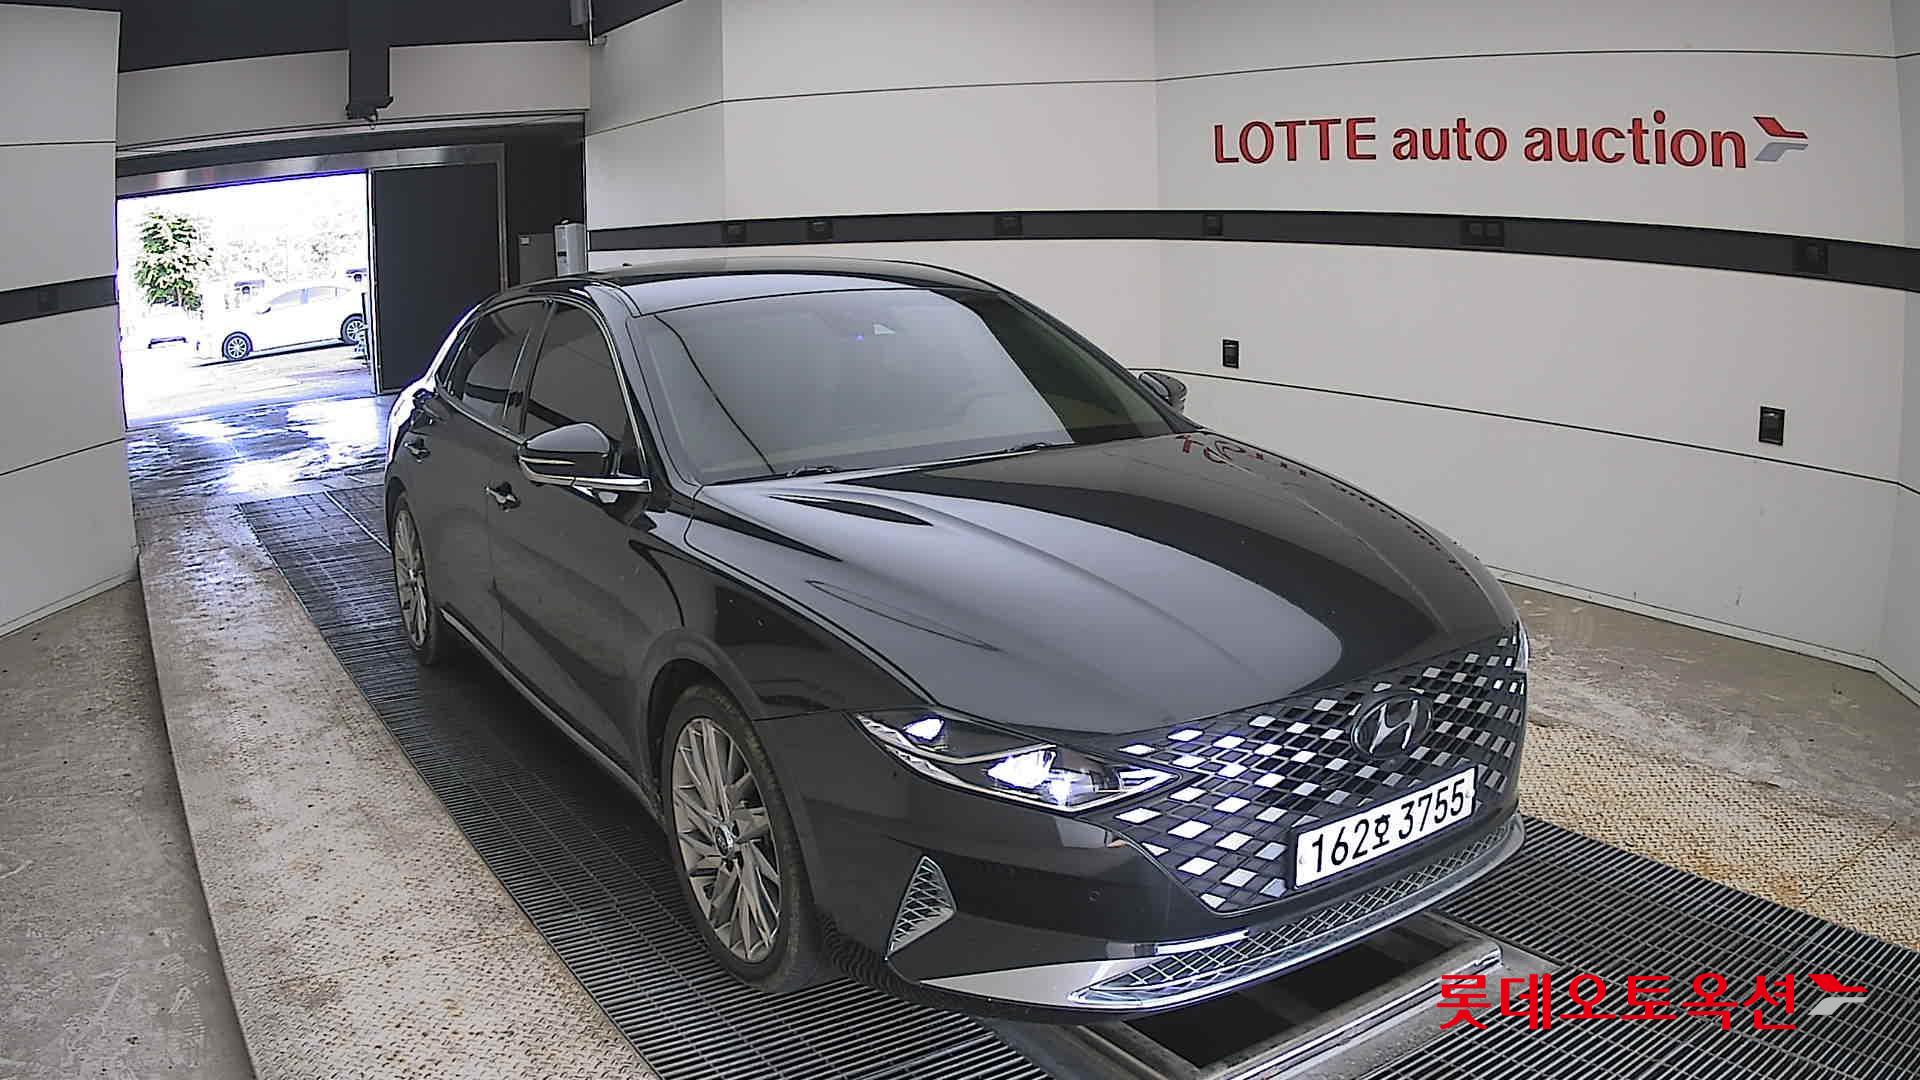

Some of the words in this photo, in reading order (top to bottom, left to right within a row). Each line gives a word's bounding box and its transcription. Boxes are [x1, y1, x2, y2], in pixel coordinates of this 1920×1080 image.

[1214, 117, 1377, 163] LOTTE
[1392, 118, 1508, 161] auto
[1523, 110, 1747, 169] auction
